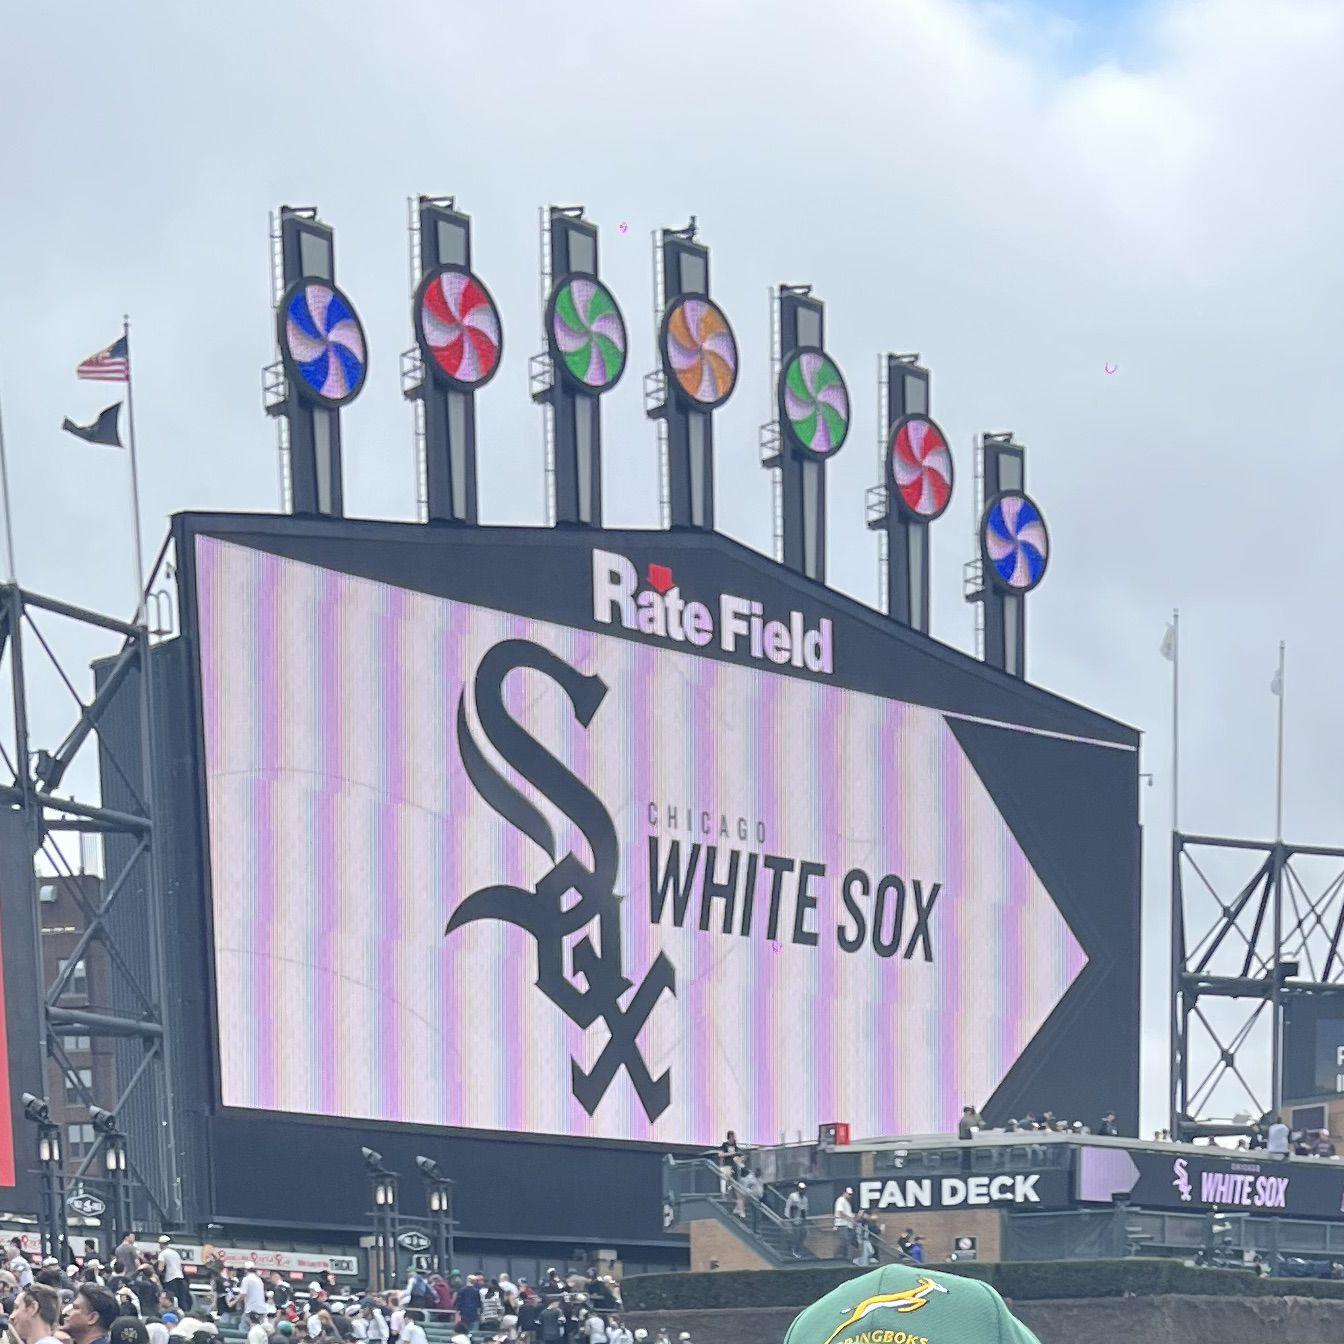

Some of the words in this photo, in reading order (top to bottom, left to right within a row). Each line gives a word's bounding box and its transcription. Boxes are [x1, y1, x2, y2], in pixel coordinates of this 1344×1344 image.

[591, 548, 714, 646] Rate
[719, 591, 834, 675] Field
[647, 801, 768, 846] CHICAGO
[647, 835, 827, 947] WHITE
[837, 868, 944, 963] SOX
[859, 1179, 931, 1209] FAN
[941, 1175, 1041, 1207] DECK
[1201, 1172, 1254, 1206] WHITE
[1254, 1177, 1289, 1208] SOX
